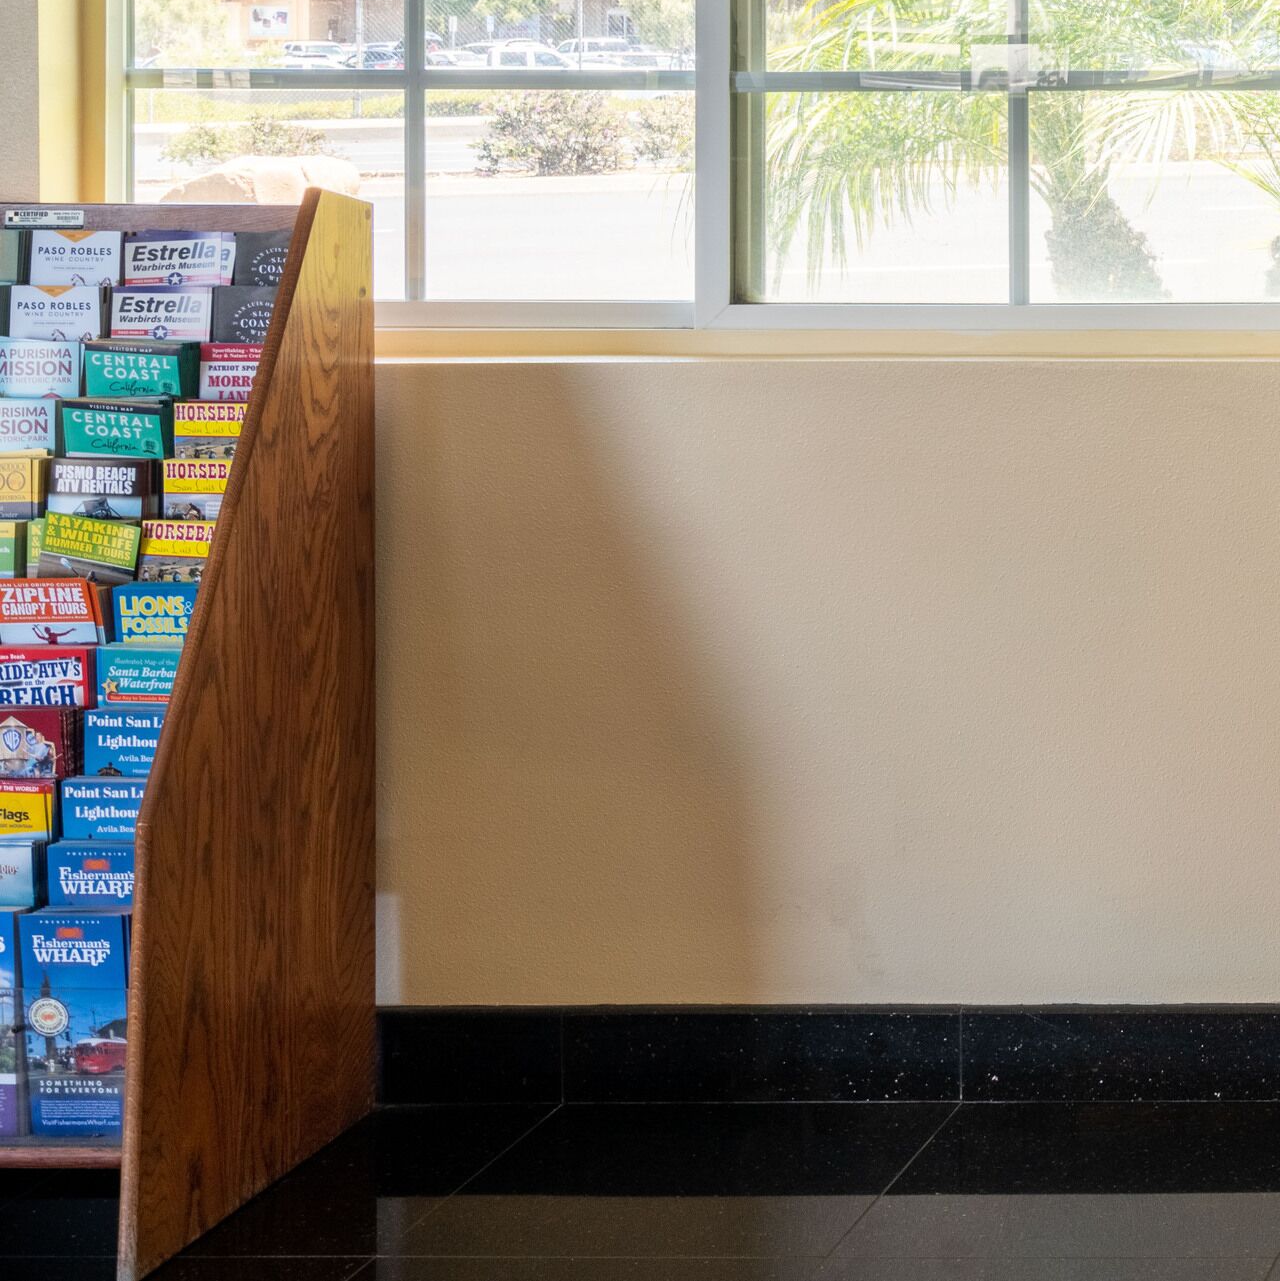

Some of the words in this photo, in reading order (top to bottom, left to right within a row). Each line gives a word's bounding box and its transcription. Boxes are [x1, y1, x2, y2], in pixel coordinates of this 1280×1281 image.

[71, 248, 112, 256] ROBLES
[132, 242, 216, 262] Estrella
[133, 263, 176, 272] Warbirds
[178, 261, 215, 270] Museum
[51, 302, 91, 310] ROBLES
[119, 296, 202, 313] Estrella
[10, 348, 72, 358] PURISIMA
[92, 354, 170, 369] CENTRAL
[104, 368, 160, 380] COAST
[208, 376, 252, 387] MORR
[110, 381, 156, 396] California
[72, 412, 153, 428] CENTRAL
[176, 406, 245, 421] HORSEBA
[0, 419, 48, 434] SION
[85, 425, 142, 439] COAST
[91, 439, 138, 452] California
[55, 465, 92, 480] PISMO
[96, 467, 136, 481] BEACH
[166, 463, 230, 478] HORSEB
[57, 479, 80, 493] ATV
[82, 480, 132, 495] RENTALS
[48, 514, 135, 539] KAYAKING
[144, 523, 215, 541] HORSEBA
[47, 526, 55, 536] &
[61, 529, 133, 551] WILDLIFE
[46, 536, 93, 553] HUMMER
[99, 546, 131, 561] TOURS
[0, 588, 84, 602] ZIPLINE
[2, 603, 45, 616] CANOPY
[51, 602, 88, 615] TOURS
[120, 596, 184, 616] LIONS
[184, 601, 193, 615] &
[122, 617, 188, 633] FOSSILS
[108, 666, 139, 677] Santa
[142, 667, 177, 677] Barbar
[119, 678, 173, 691] Waterfron
[0, 685, 75, 705] BEACH
[88, 715, 122, 727] Point
[126, 716, 150, 727] San
[98, 735, 157, 749] Lighthou
[64, 787, 100, 798] Point
[103, 787, 128, 798] San
[76, 806, 139, 821] Lighthous
[59, 867, 135, 880] Fisherman's
[60, 880, 134, 898] WHARF
[32, 935, 110, 949] Fisherman's
[33, 949, 110, 966] WHARF
